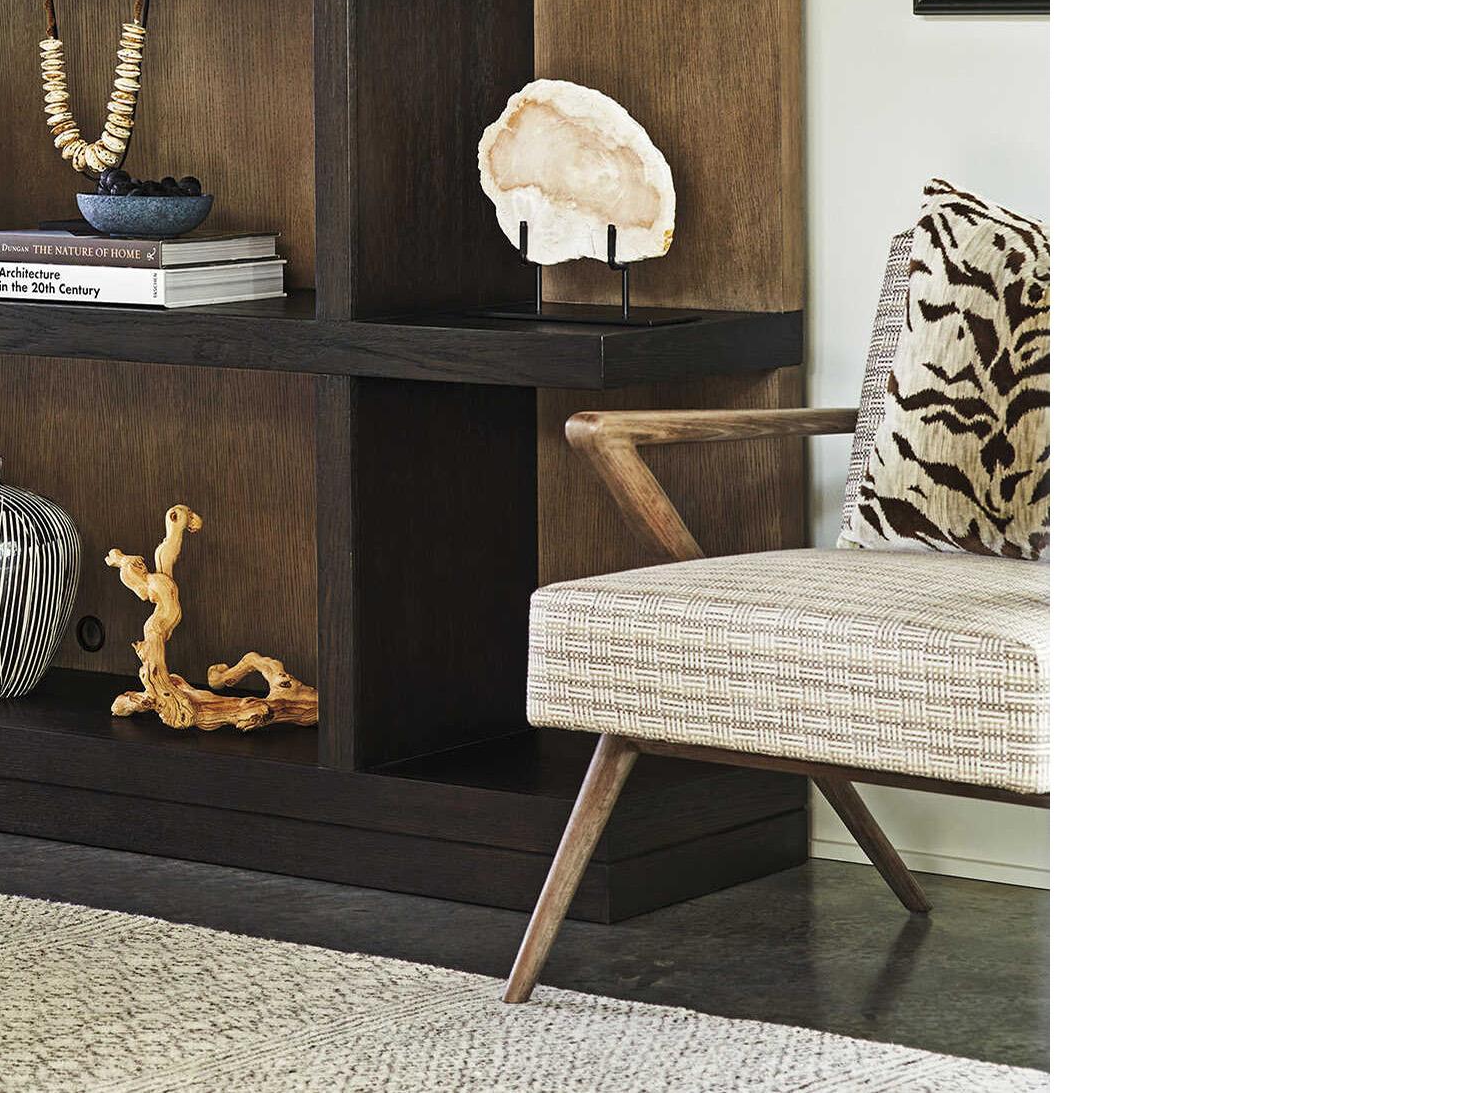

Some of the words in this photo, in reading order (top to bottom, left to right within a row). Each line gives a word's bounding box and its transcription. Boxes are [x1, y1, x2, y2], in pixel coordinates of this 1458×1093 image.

[32, 244, 53, 255] THE
[54, 245, 93, 256] NATURE
[95, 247, 109, 258] OF
[111, 248, 141, 259] HOME
[11, 281, 28, 293] the
[31, 281, 55, 294] 20th
[59, 283, 101, 298] Century
